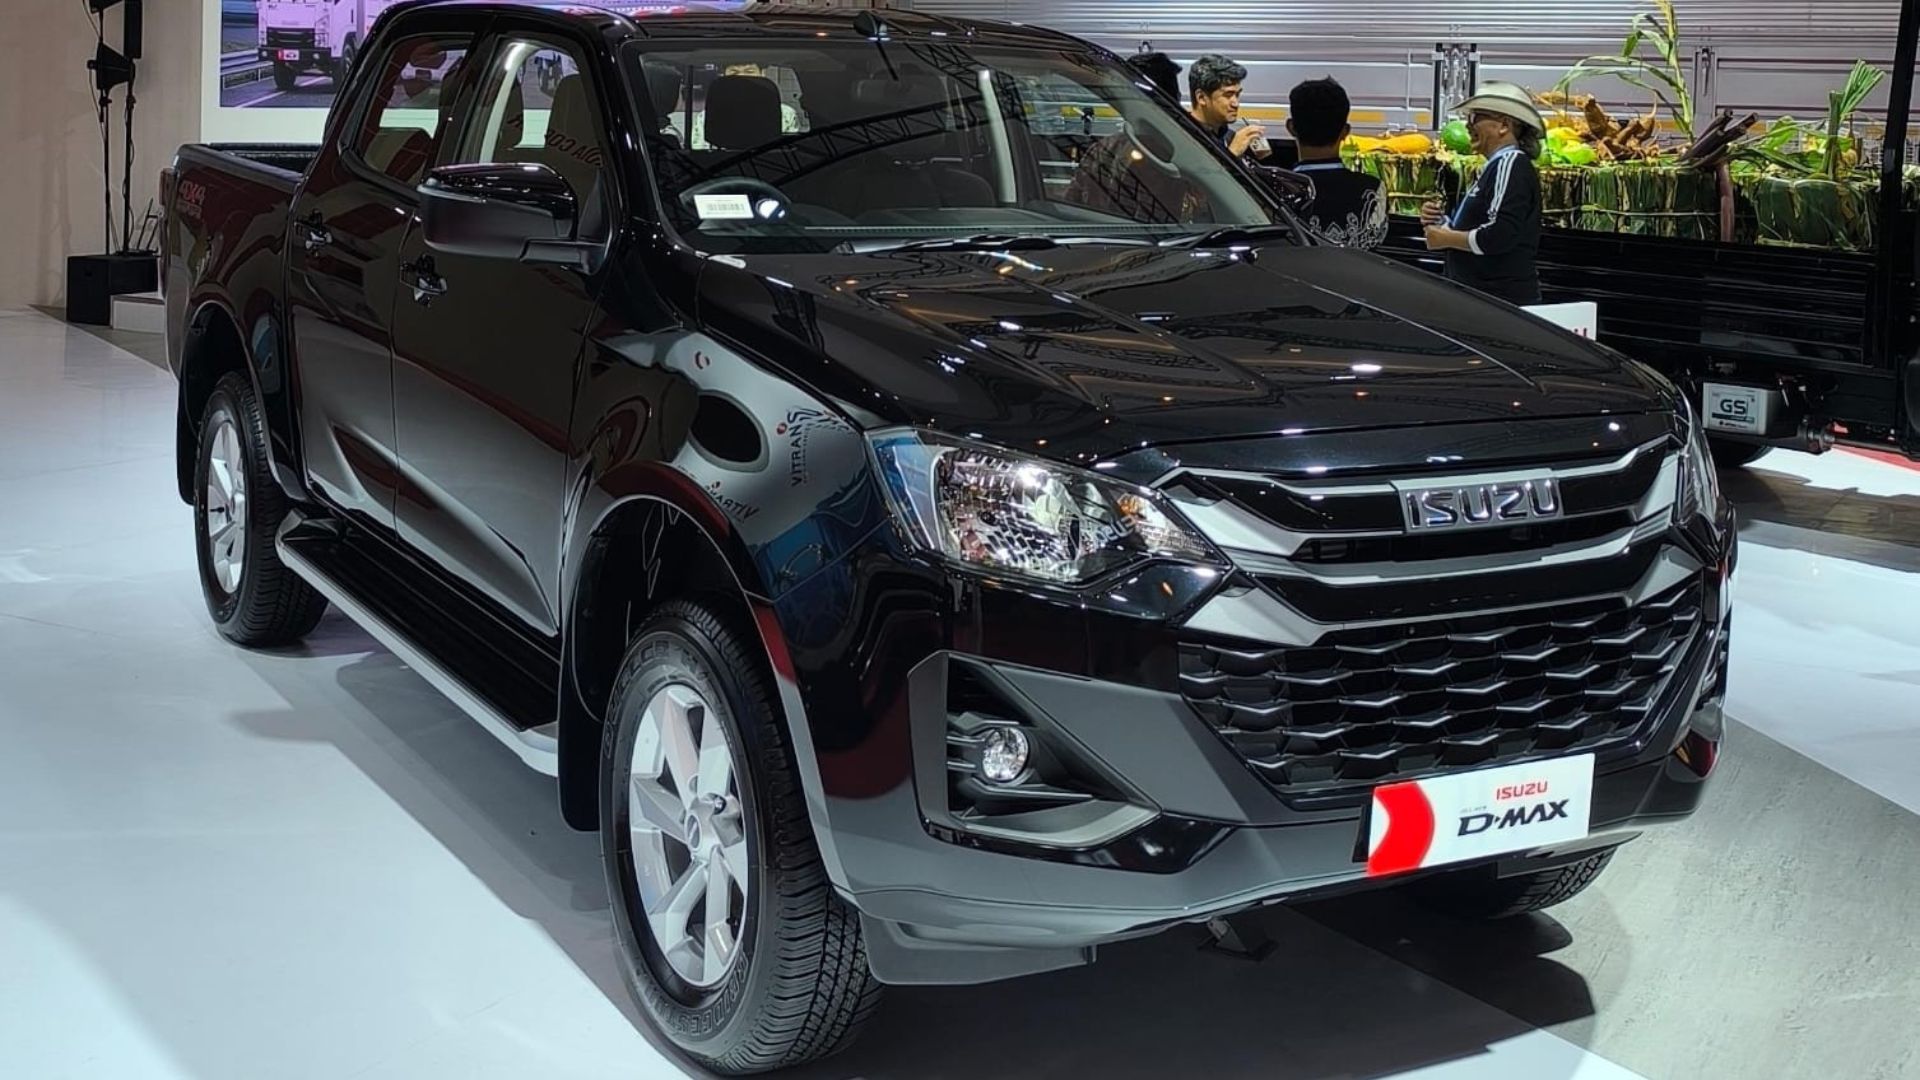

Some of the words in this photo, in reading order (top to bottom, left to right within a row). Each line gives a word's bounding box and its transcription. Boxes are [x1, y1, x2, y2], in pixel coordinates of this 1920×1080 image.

[1720, 399, 1747, 415] GS
[1406, 479, 1559, 528] ISUZU
[1496, 780, 1549, 801] ISUZU
[641, 948, 750, 1037] BRIDGEST
